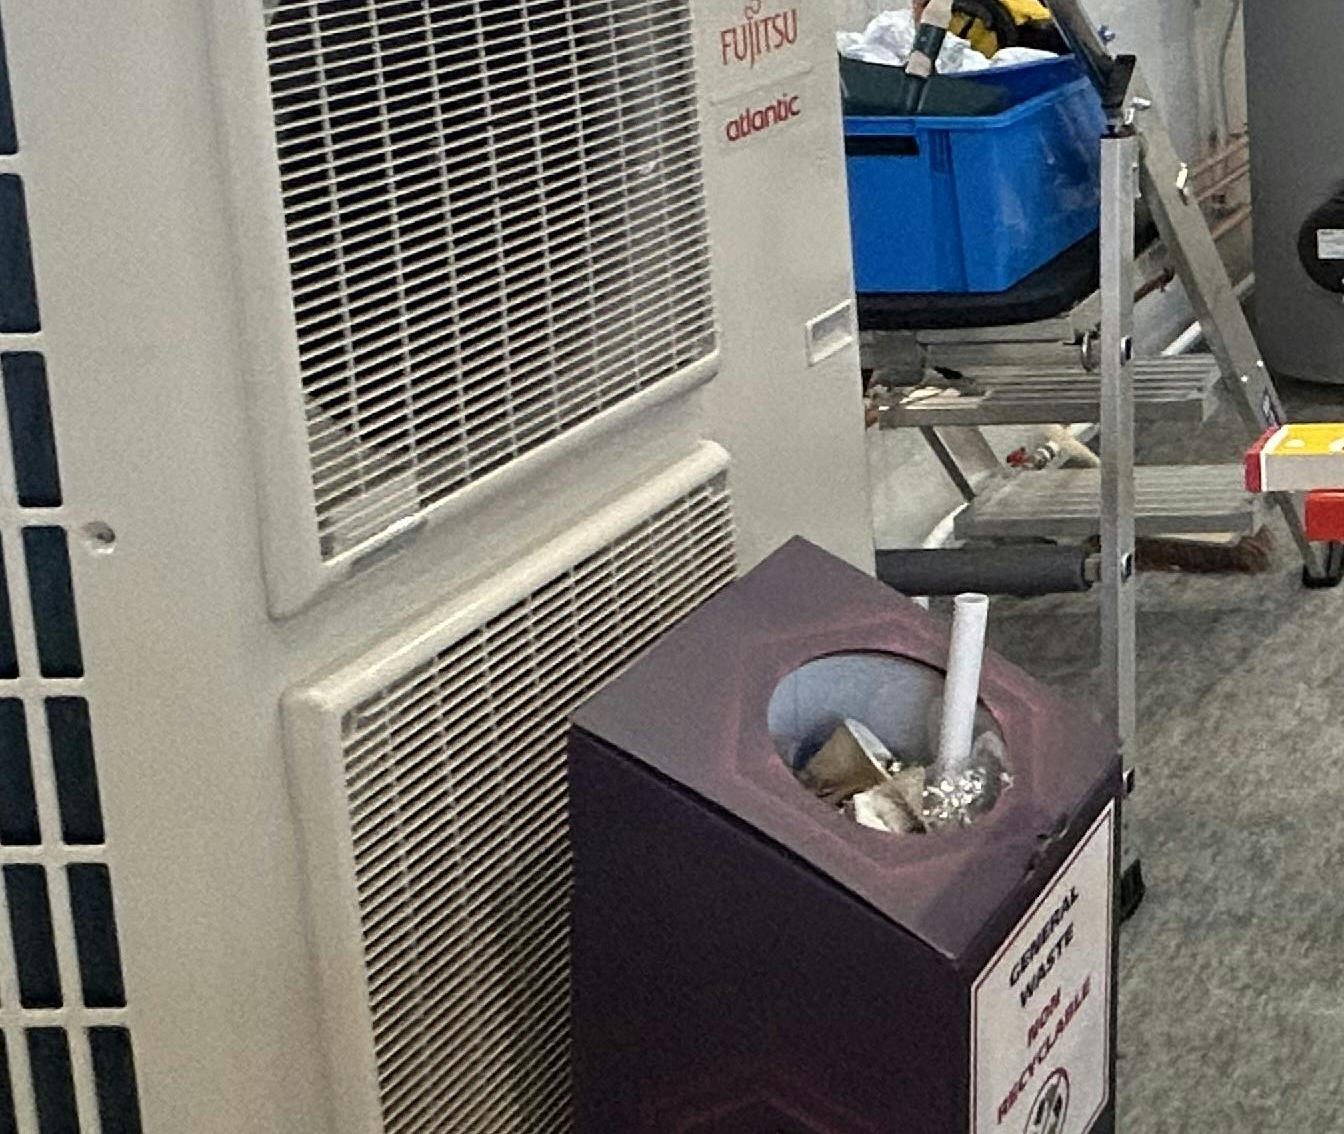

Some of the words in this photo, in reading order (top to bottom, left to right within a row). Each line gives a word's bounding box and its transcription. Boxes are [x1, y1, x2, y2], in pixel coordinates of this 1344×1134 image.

[721, 8, 798, 69] FUJITSU
[726, 92, 801, 141] atlantic
[1009, 886, 1079, 988] GENERAL
[1020, 921, 1074, 1009] WASTE
[997, 975, 1091, 1125] RECYCLABLE
[1027, 986, 1062, 1050] NON
